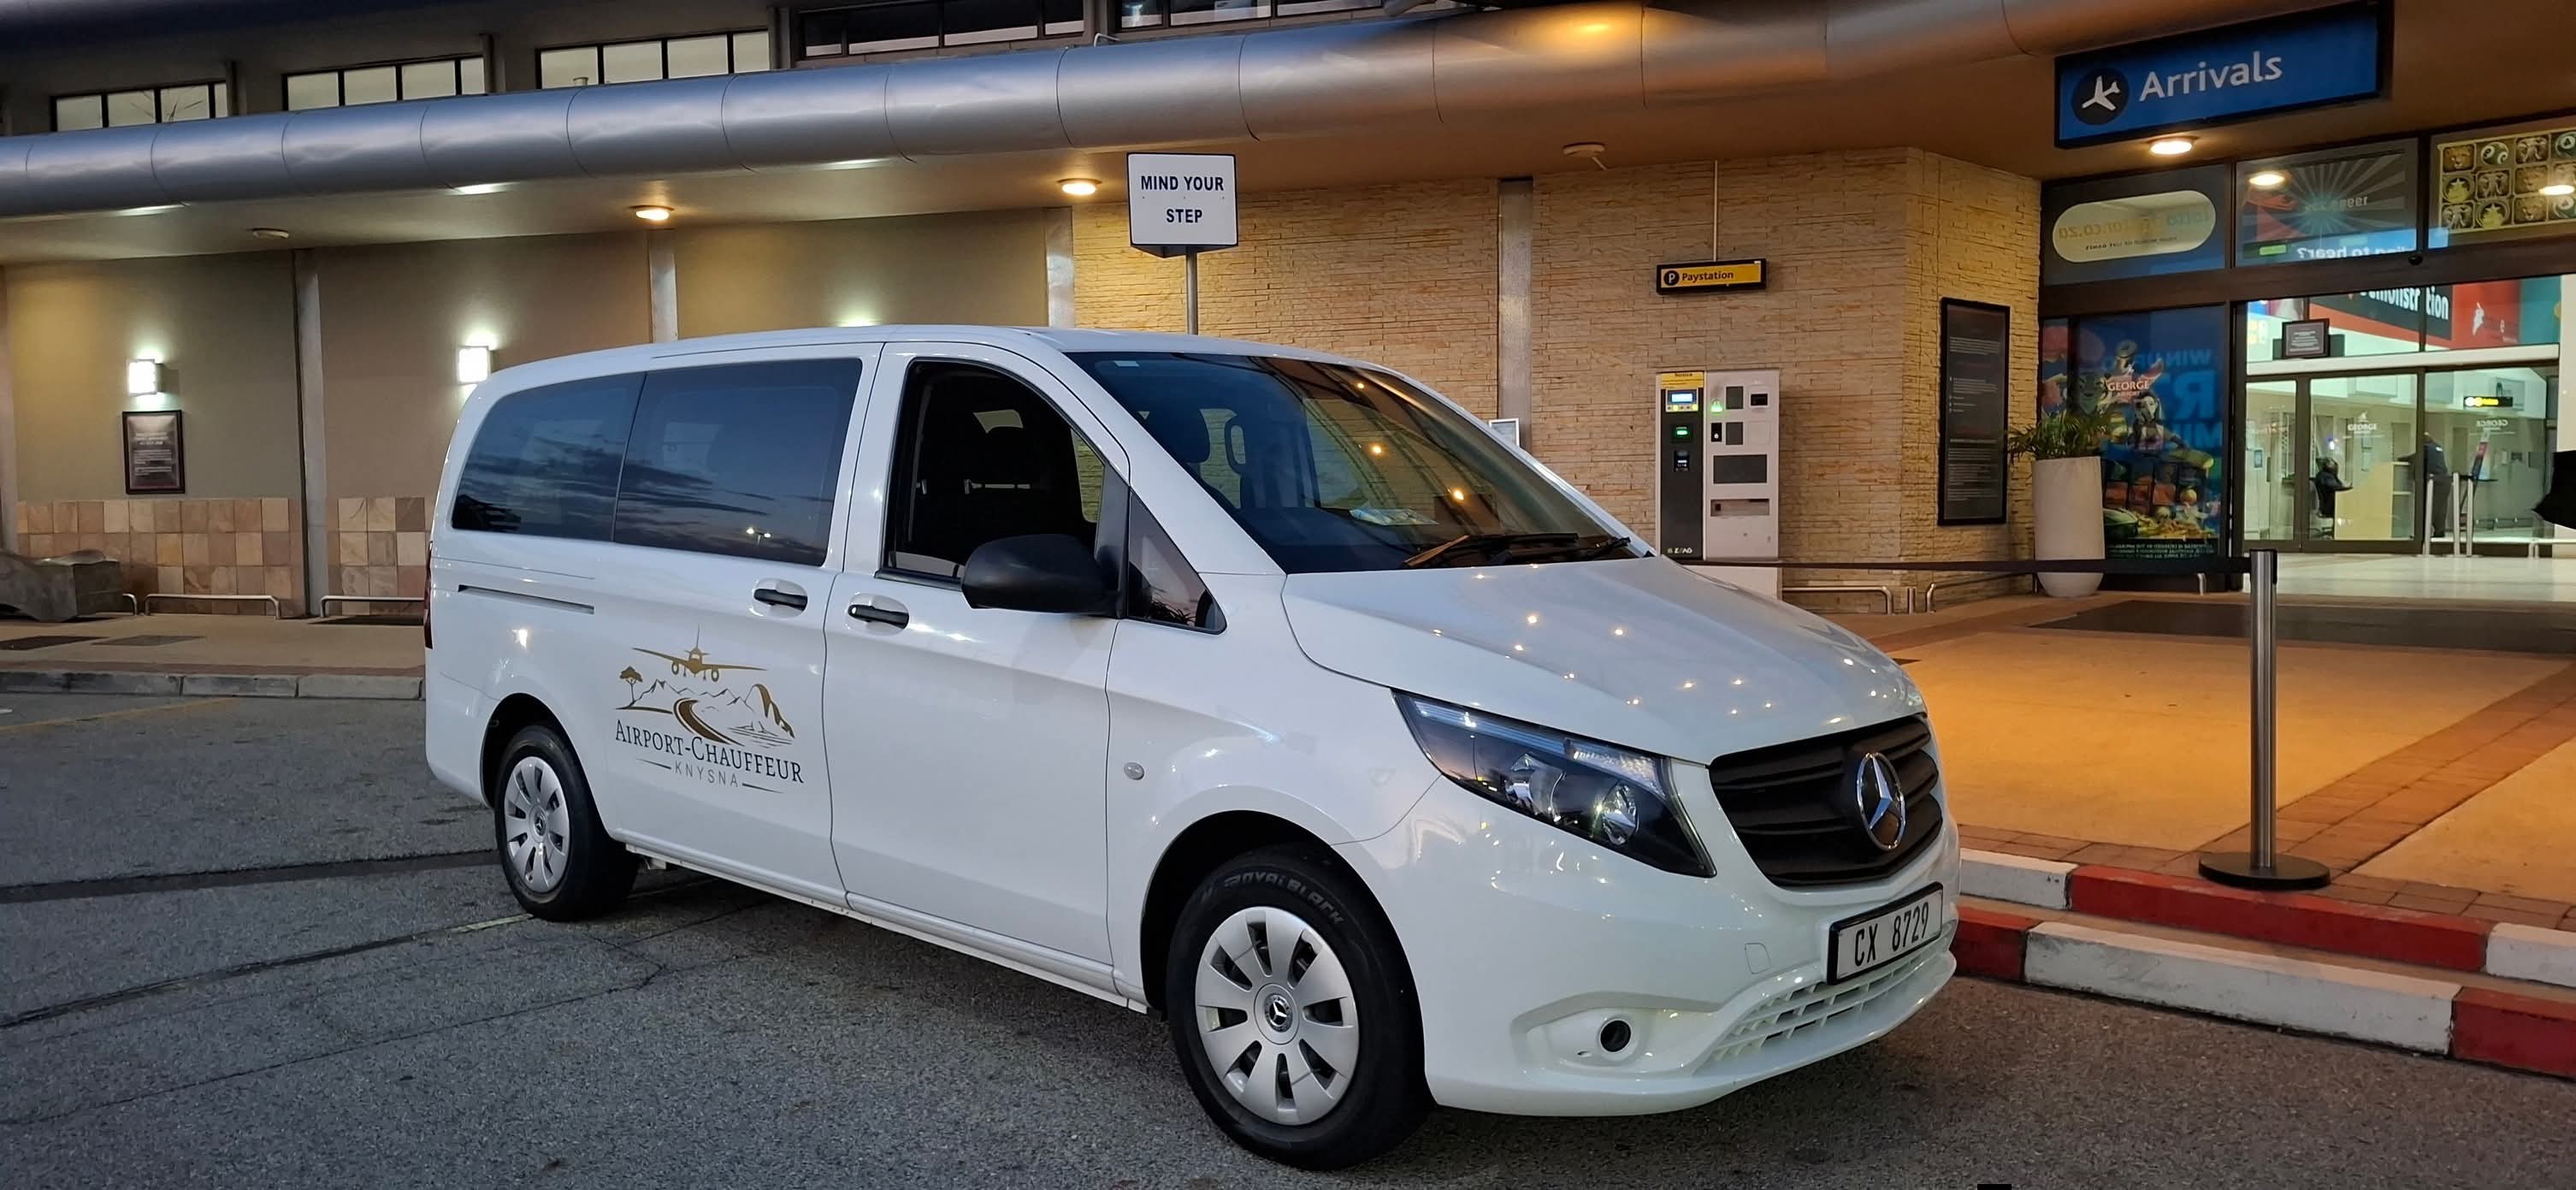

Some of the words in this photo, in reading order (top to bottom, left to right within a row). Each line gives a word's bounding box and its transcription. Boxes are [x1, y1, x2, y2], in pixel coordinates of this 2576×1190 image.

[2139, 50, 2283, 102] Arrivals
[1141, 175, 1179, 190] MIND
[1184, 176, 1224, 191] YOUR
[1167, 209, 1202, 223] STEP
[1682, 270, 1734, 283] Paystation
[675, 760, 739, 788] KNYSNA
[1854, 923, 1878, 967] CX
[1892, 902, 1929, 951] 8729
